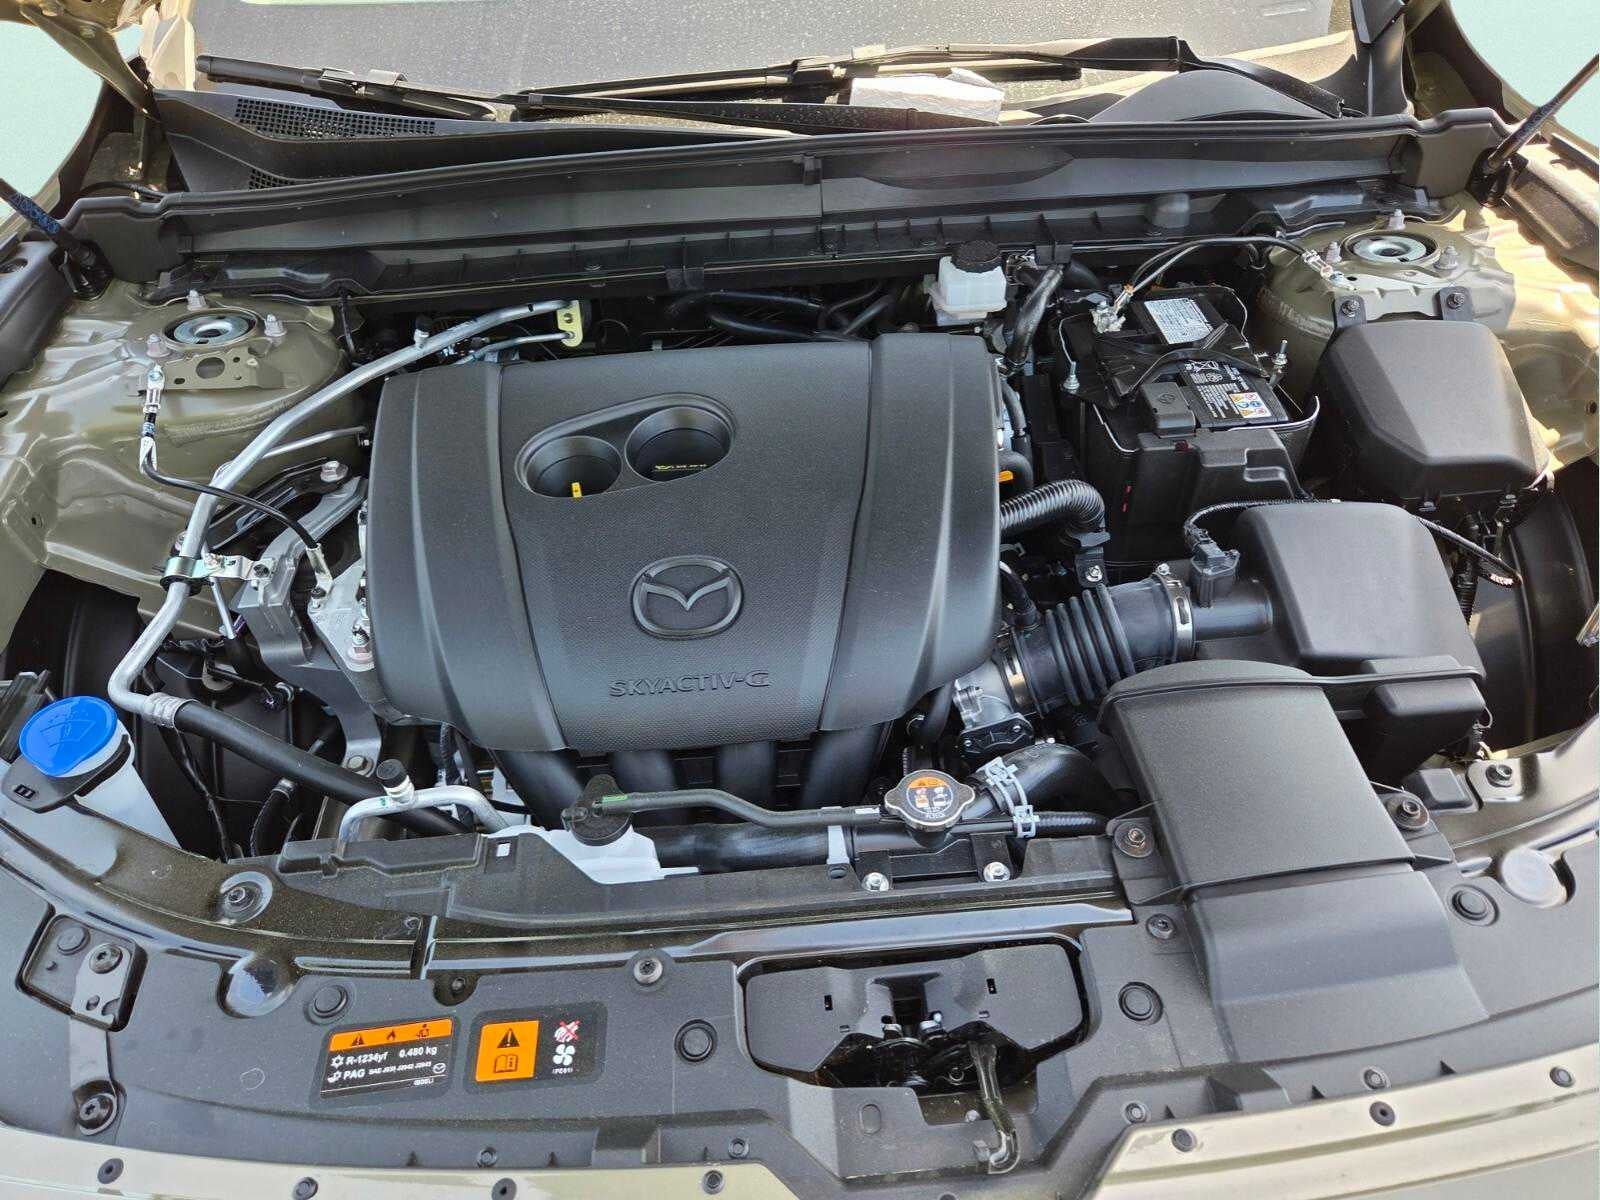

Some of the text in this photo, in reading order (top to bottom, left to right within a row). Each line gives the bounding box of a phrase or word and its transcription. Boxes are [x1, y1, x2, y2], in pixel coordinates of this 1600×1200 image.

[609, 670, 771, 698] SKYACTIV-G
[346, 1051, 389, 1066] R-1234yf
[425, 1046, 438, 1056] kg
[343, 1069, 366, 1080] PAG
